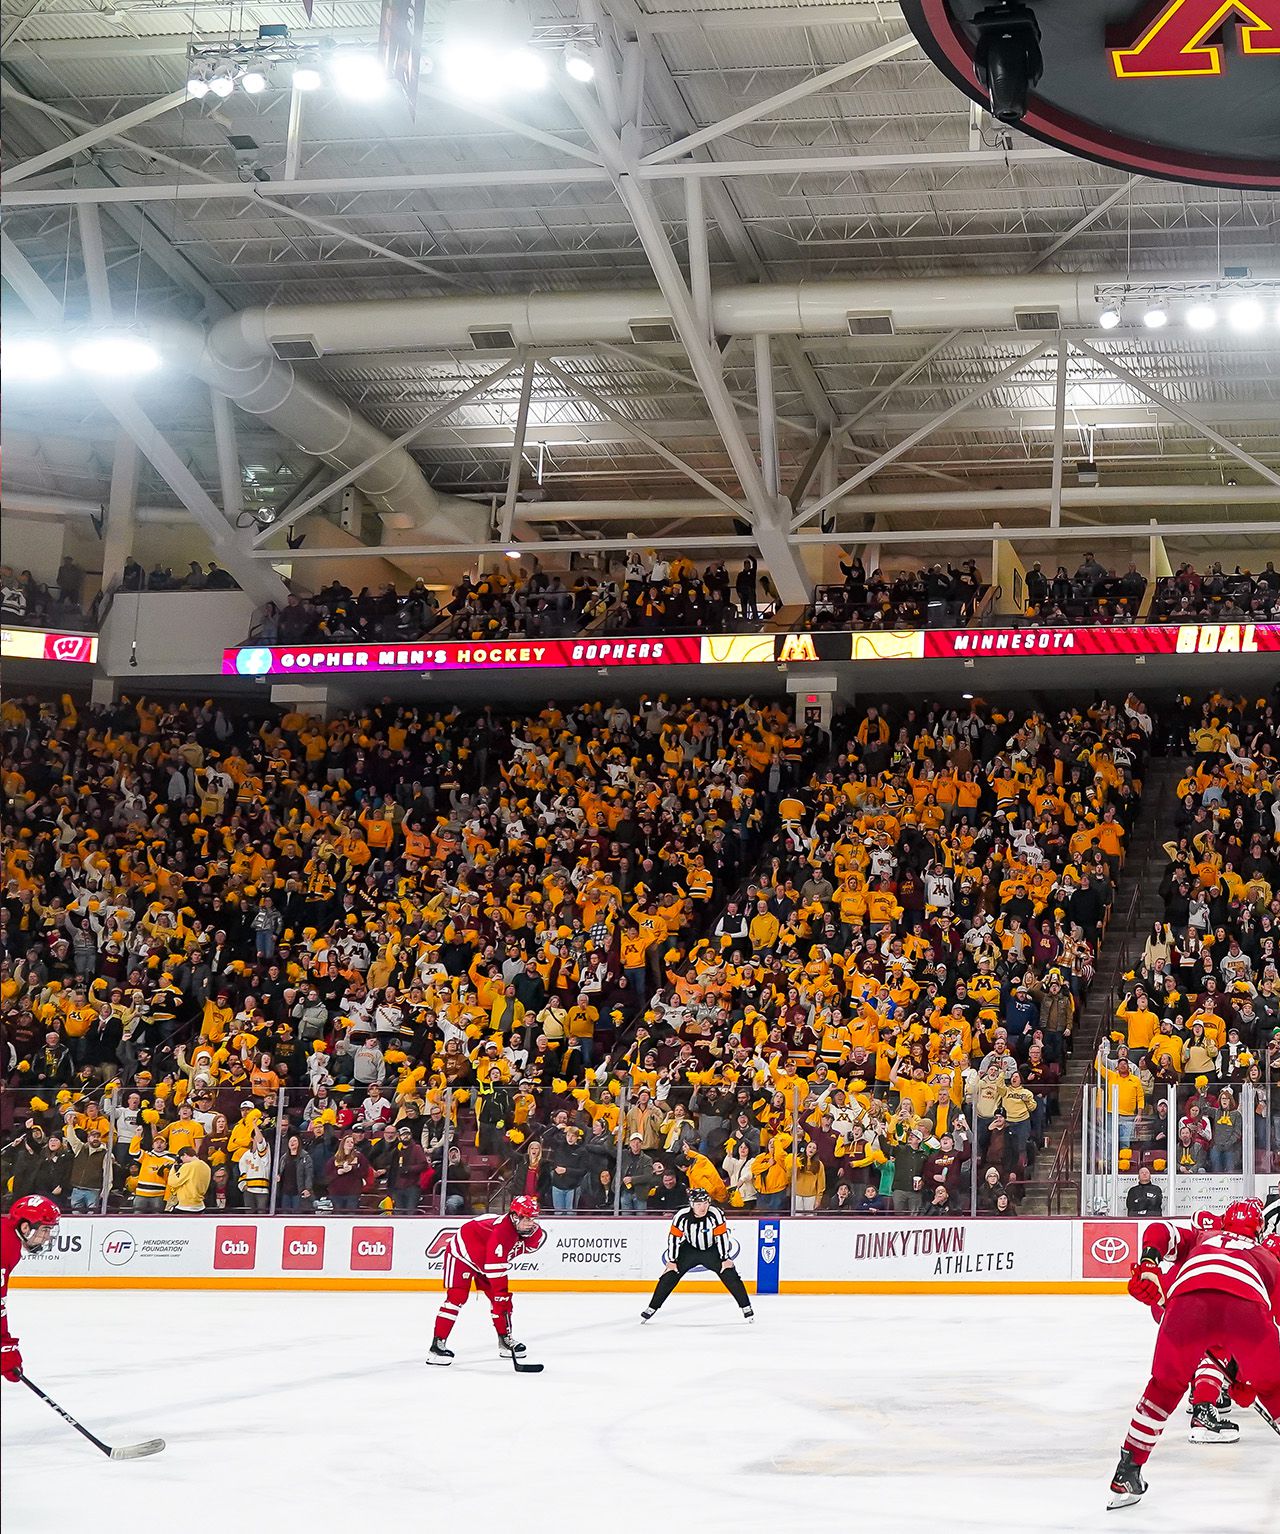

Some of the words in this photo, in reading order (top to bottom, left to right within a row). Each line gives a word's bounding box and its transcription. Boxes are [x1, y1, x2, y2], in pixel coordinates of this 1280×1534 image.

[954, 632, 1075, 651] MINNESOTA
[281, 652, 369, 667] GOPHER
[379, 649, 447, 665] MEN'S
[457, 647, 547, 663] HOCKEY
[572, 643, 664, 661] GOPHERS
[106, 1241, 132, 1253] HF
[221, 1240, 249, 1256] Cub
[289, 1240, 318, 1256] Cub
[357, 1240, 386, 1257] Cub
[494, 1243, 503, 1258] 4
[556, 1238, 627, 1249] AUTOMOTIVE
[855, 1227, 965, 1260] DINKYTOWN
[562, 1252, 621, 1263] PRODUCTS
[934, 1252, 1014, 1276] ATHLETES
